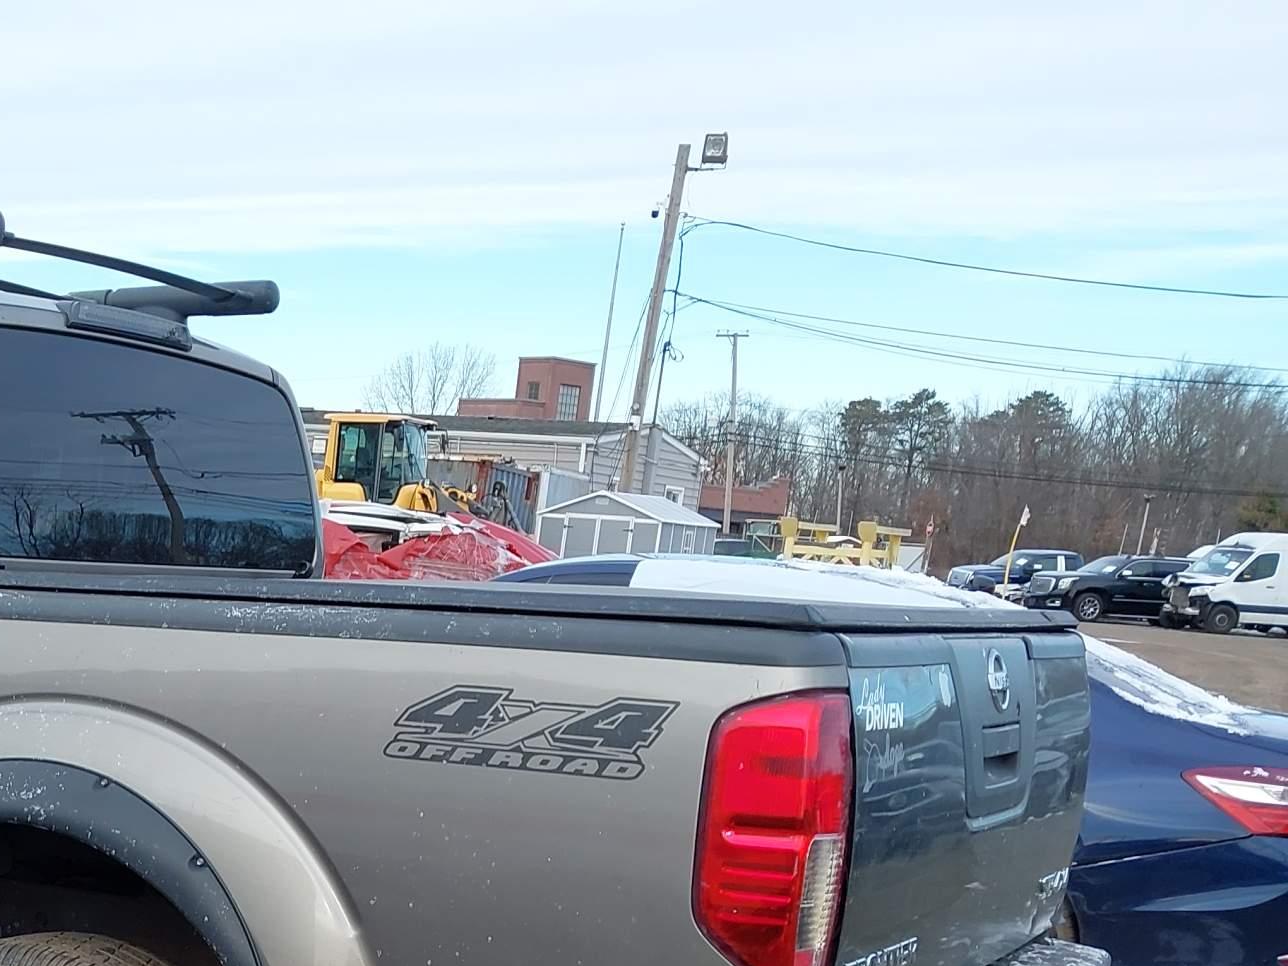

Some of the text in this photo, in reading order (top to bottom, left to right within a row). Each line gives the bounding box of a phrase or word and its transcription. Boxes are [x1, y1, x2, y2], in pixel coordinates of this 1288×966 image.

[855, 672, 886, 716] Lady
[865, 702, 904, 732] DRIVEN
[384, 741, 644, 778] OFF ROAD
